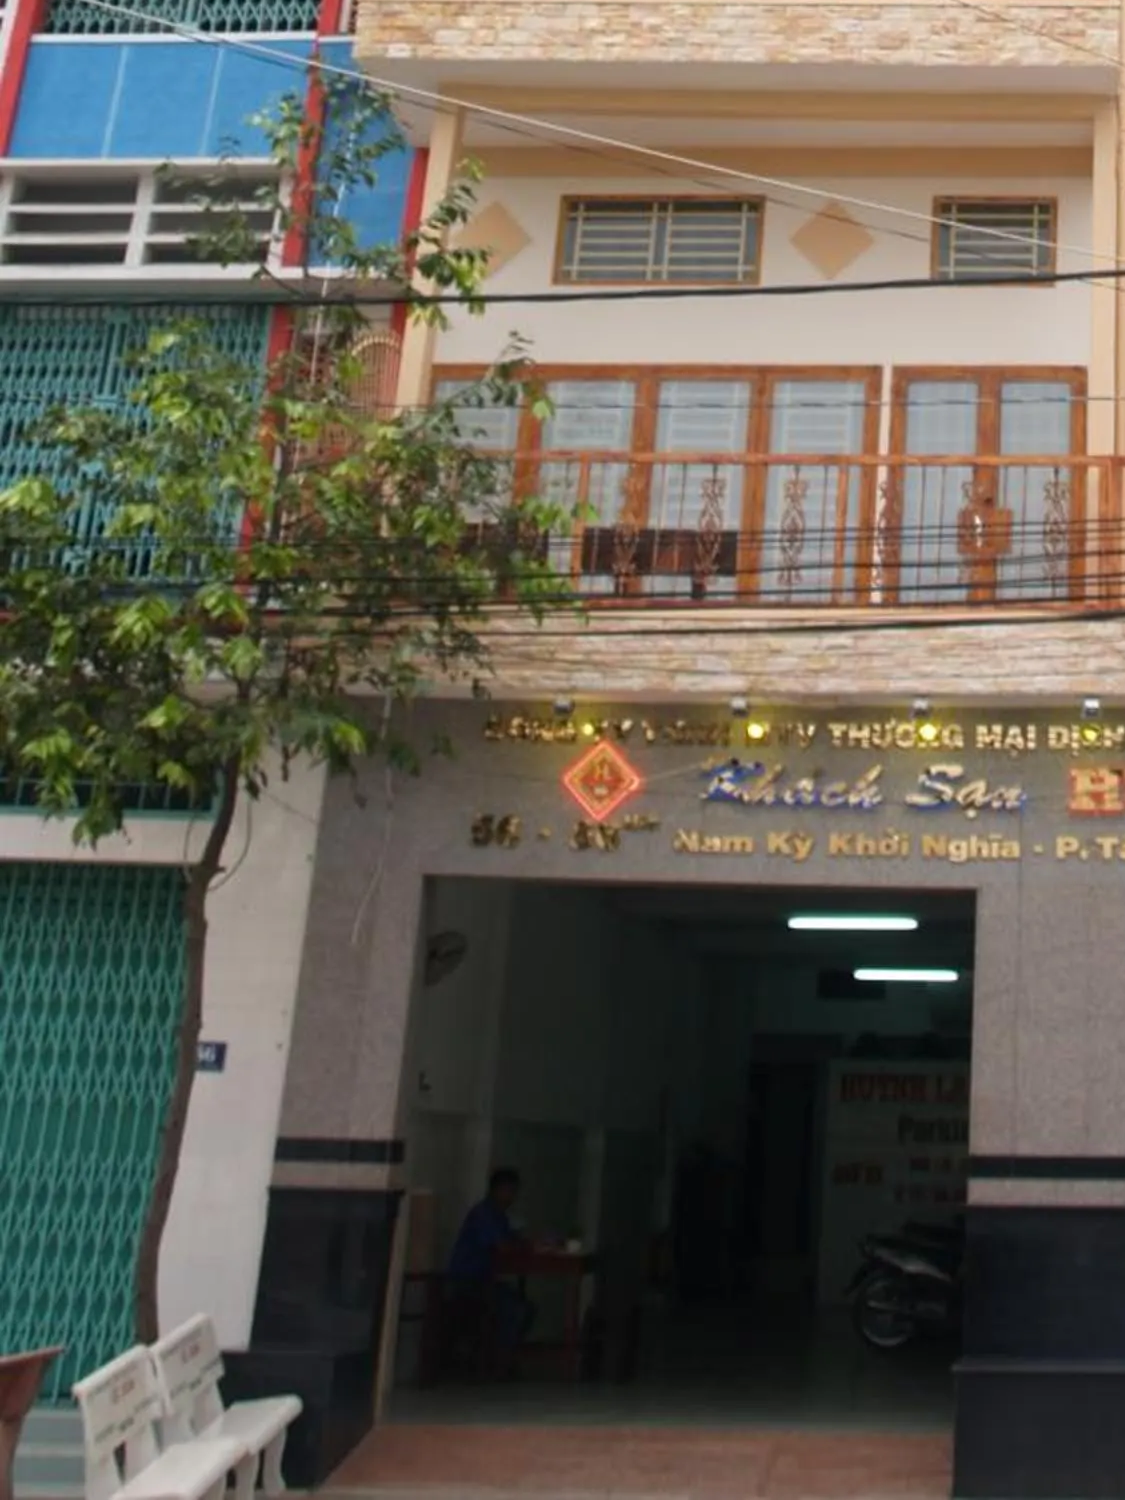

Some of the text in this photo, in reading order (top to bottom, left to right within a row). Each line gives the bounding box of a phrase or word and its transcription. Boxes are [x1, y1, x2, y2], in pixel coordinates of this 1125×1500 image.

[976, 724, 1036, 756] MẠI
[903, 761, 1028, 820] Sạn
[672, 829, 755, 855] Nam
[767, 827, 813, 860] Kỳ
[922, 831, 1022, 863] Nghĩa
